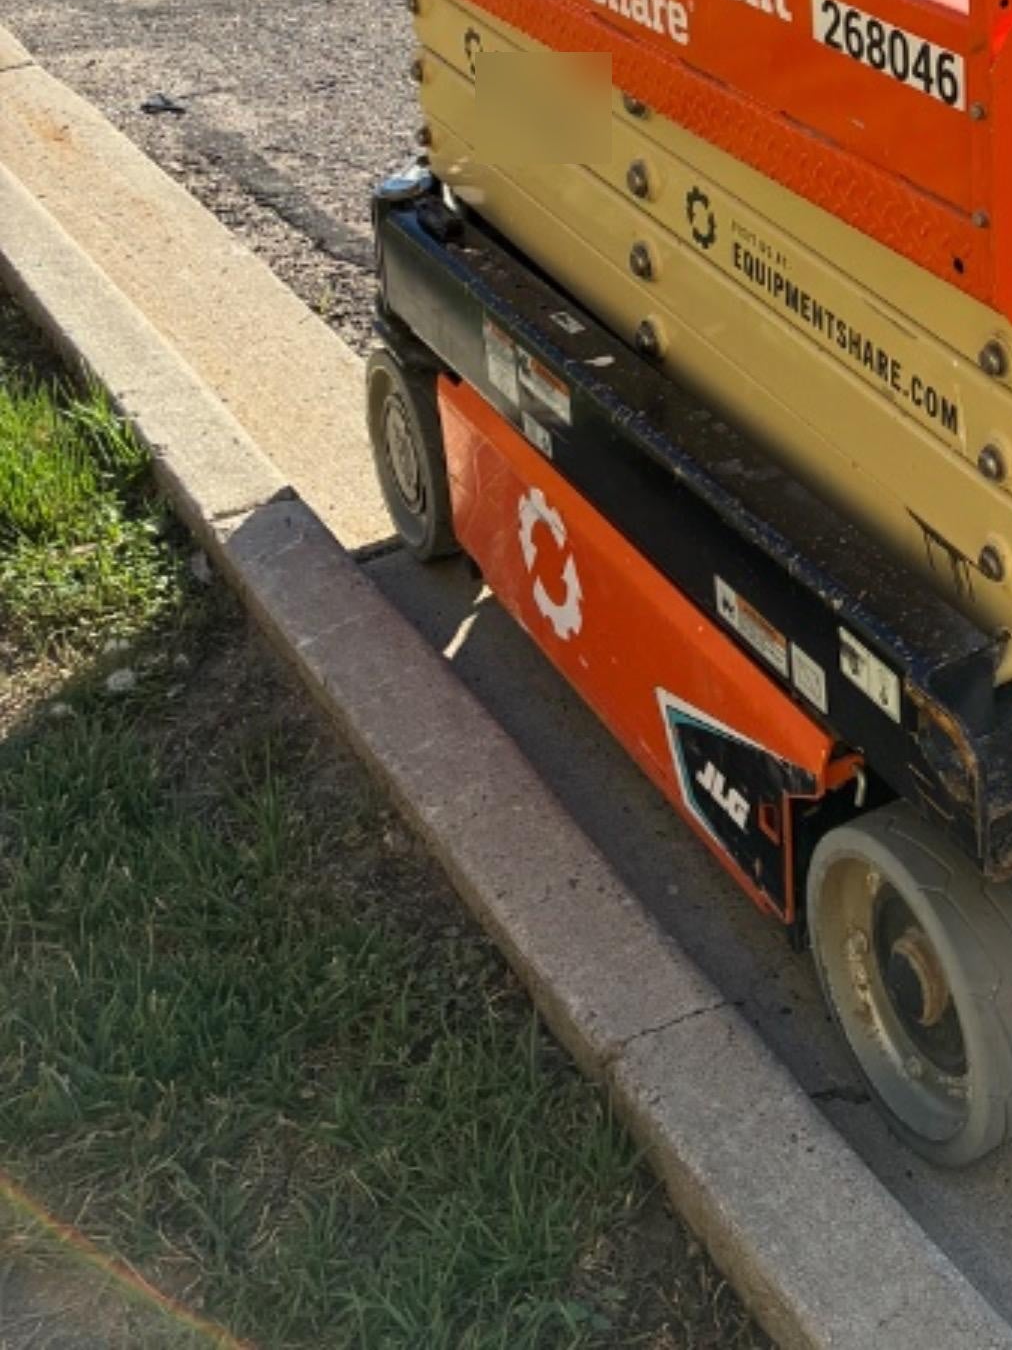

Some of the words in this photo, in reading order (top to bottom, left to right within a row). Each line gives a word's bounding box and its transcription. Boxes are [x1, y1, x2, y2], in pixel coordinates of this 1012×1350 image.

[820, 0, 959, 105] 268046
[733, 242, 959, 436] EQUIPMENTSHARE.COM
[697, 760, 750, 830] JLG
